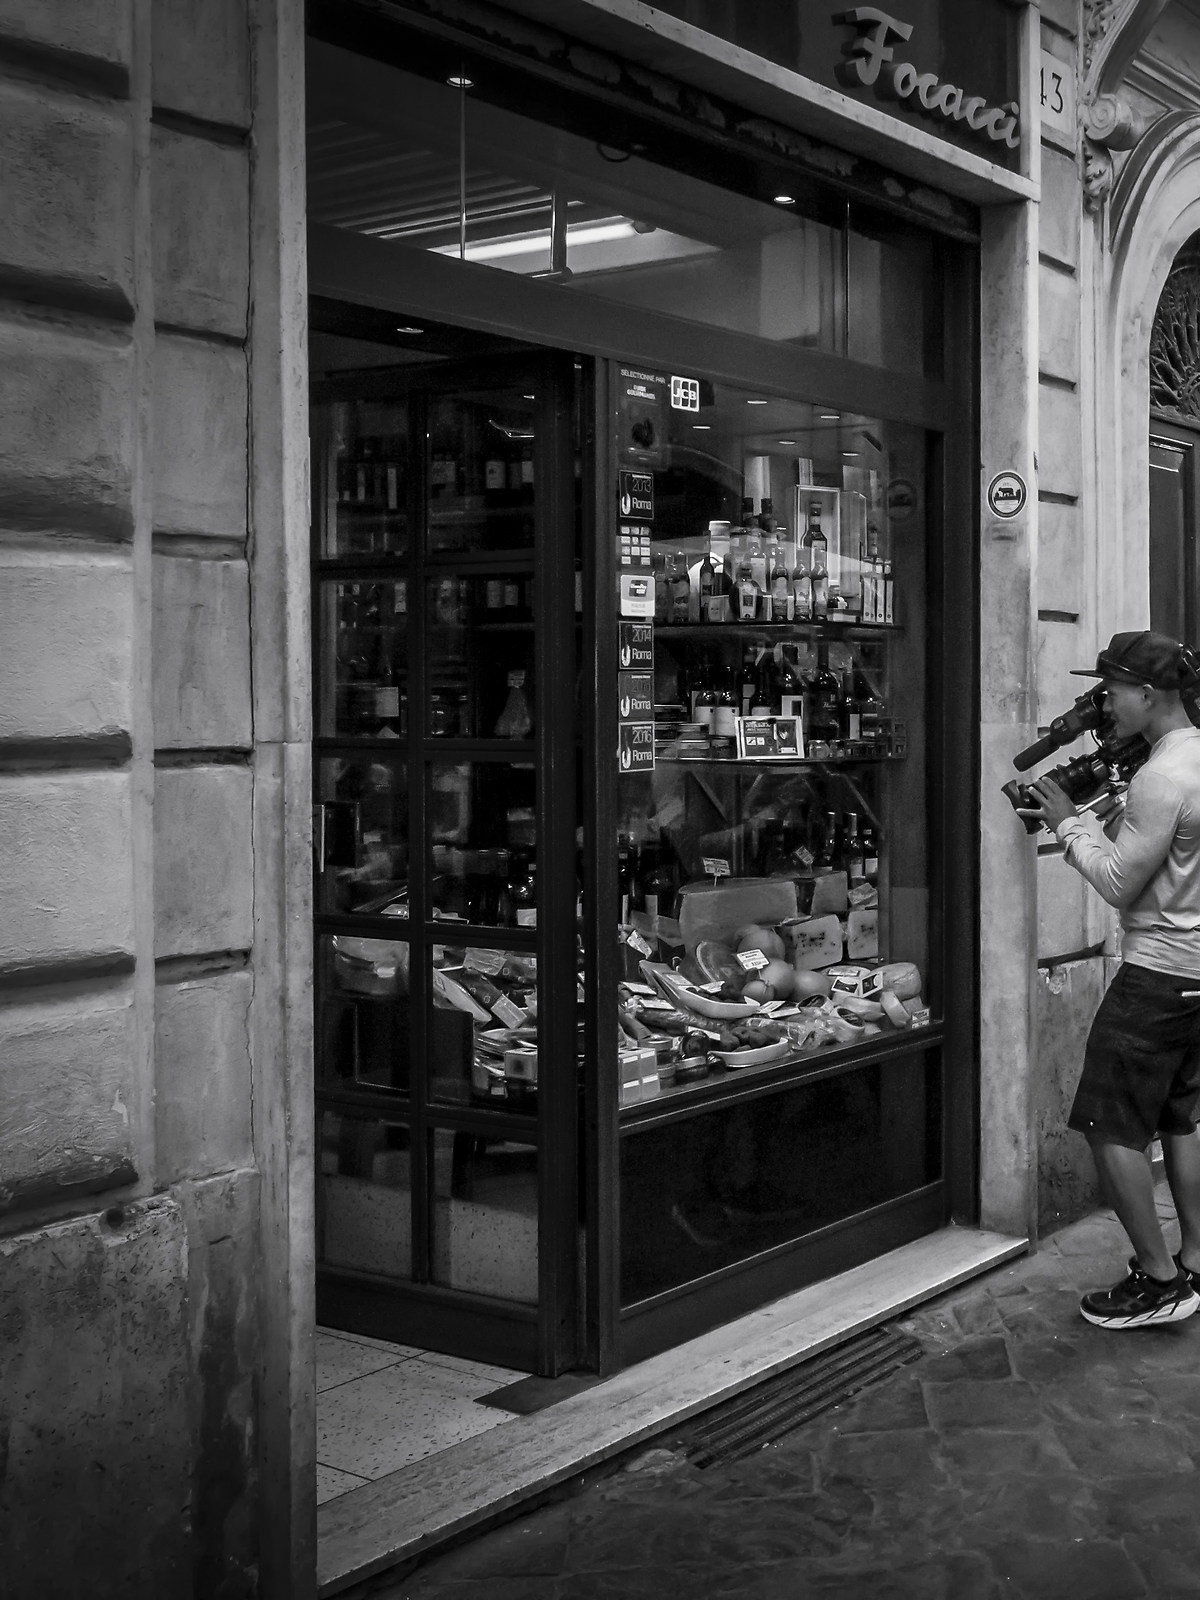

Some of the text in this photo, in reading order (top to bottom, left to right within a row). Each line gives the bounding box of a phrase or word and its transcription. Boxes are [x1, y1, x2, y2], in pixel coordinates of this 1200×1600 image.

[845, 6, 1020, 148] Focacci
[673, 387, 697, 401] JCB
[632, 478, 651, 493] 2013
[632, 497, 652, 510] Roma
[632, 628, 652, 642] 2014
[632, 648, 652, 660] Roma
[631, 698, 651, 710] Roma
[632, 729, 652, 744] 2016
[632, 749, 652, 761] Roma
